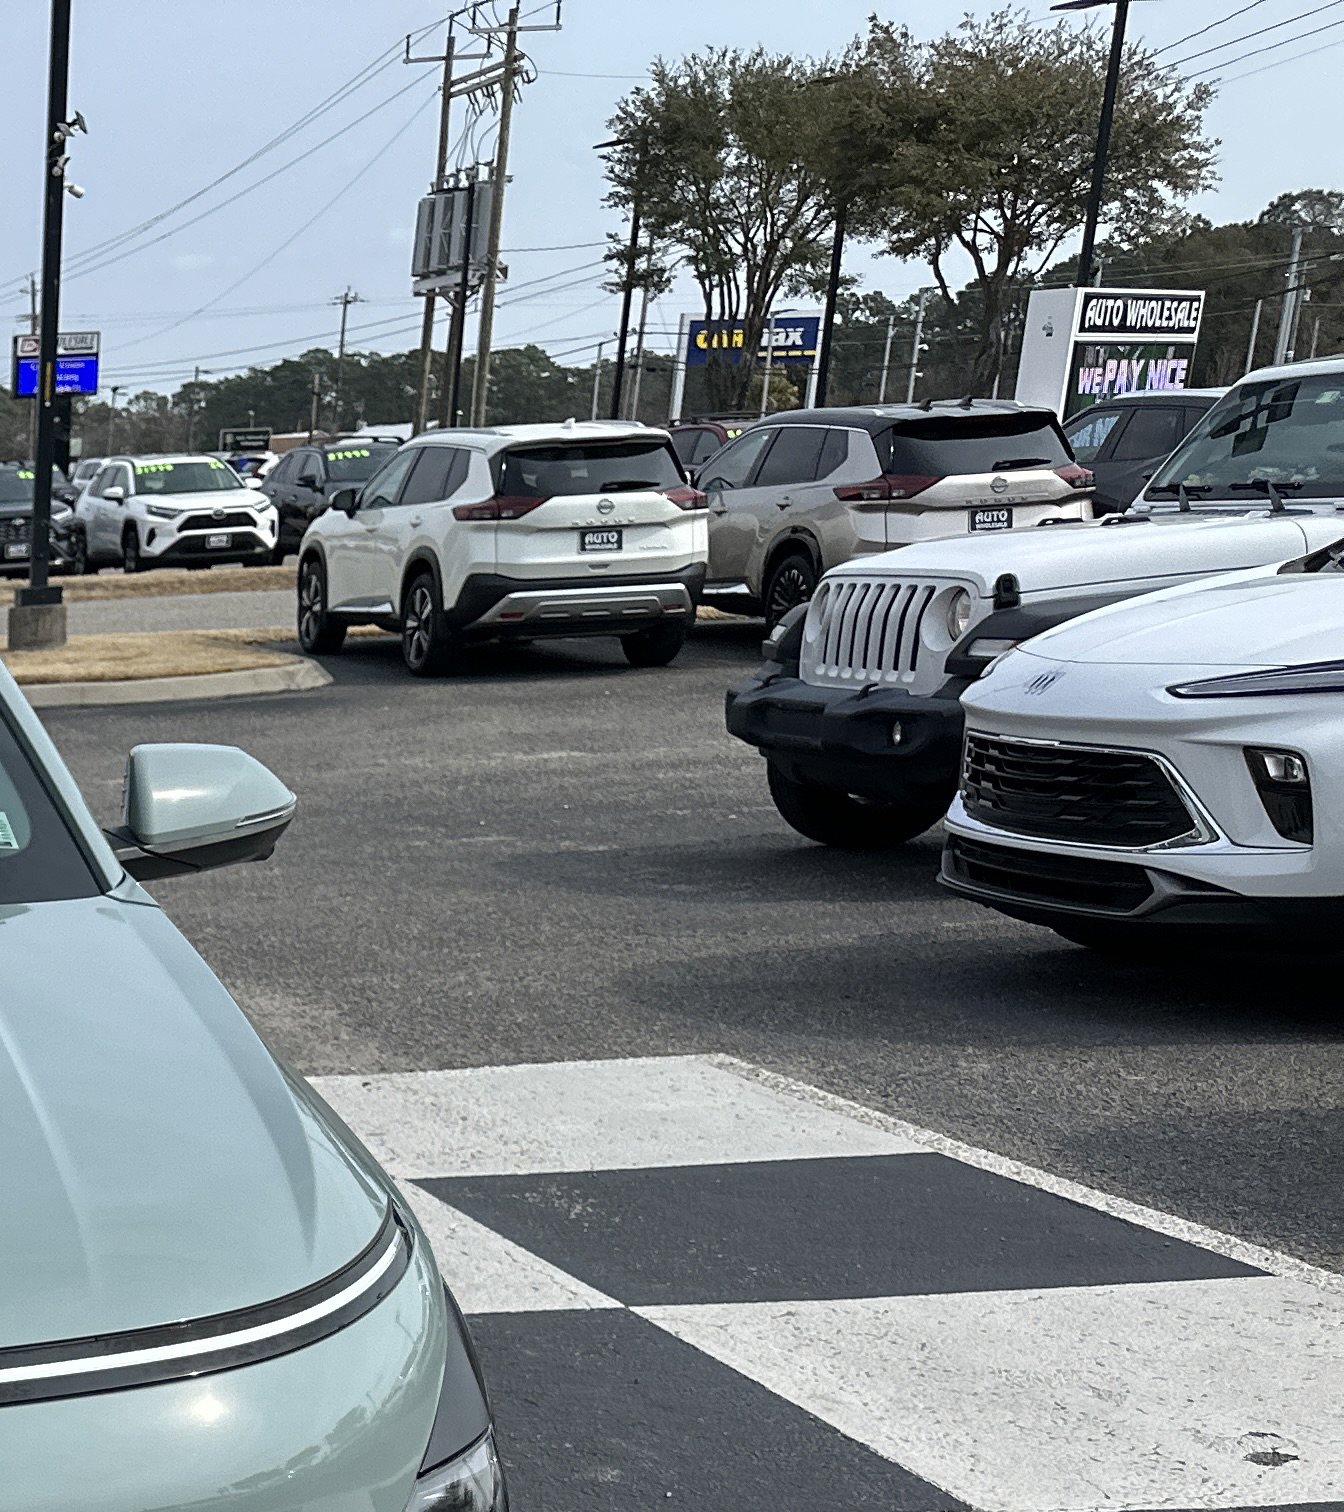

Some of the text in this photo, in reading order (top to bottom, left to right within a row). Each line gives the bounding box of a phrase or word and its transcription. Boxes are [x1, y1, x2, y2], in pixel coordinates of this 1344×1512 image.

[1085, 299, 1199, 329] AUTO WHOLESALE
[1078, 359, 1188, 394] WE PAY NICE
[975, 510, 1008, 523] AUTO
[585, 531, 618, 544] AUTO
